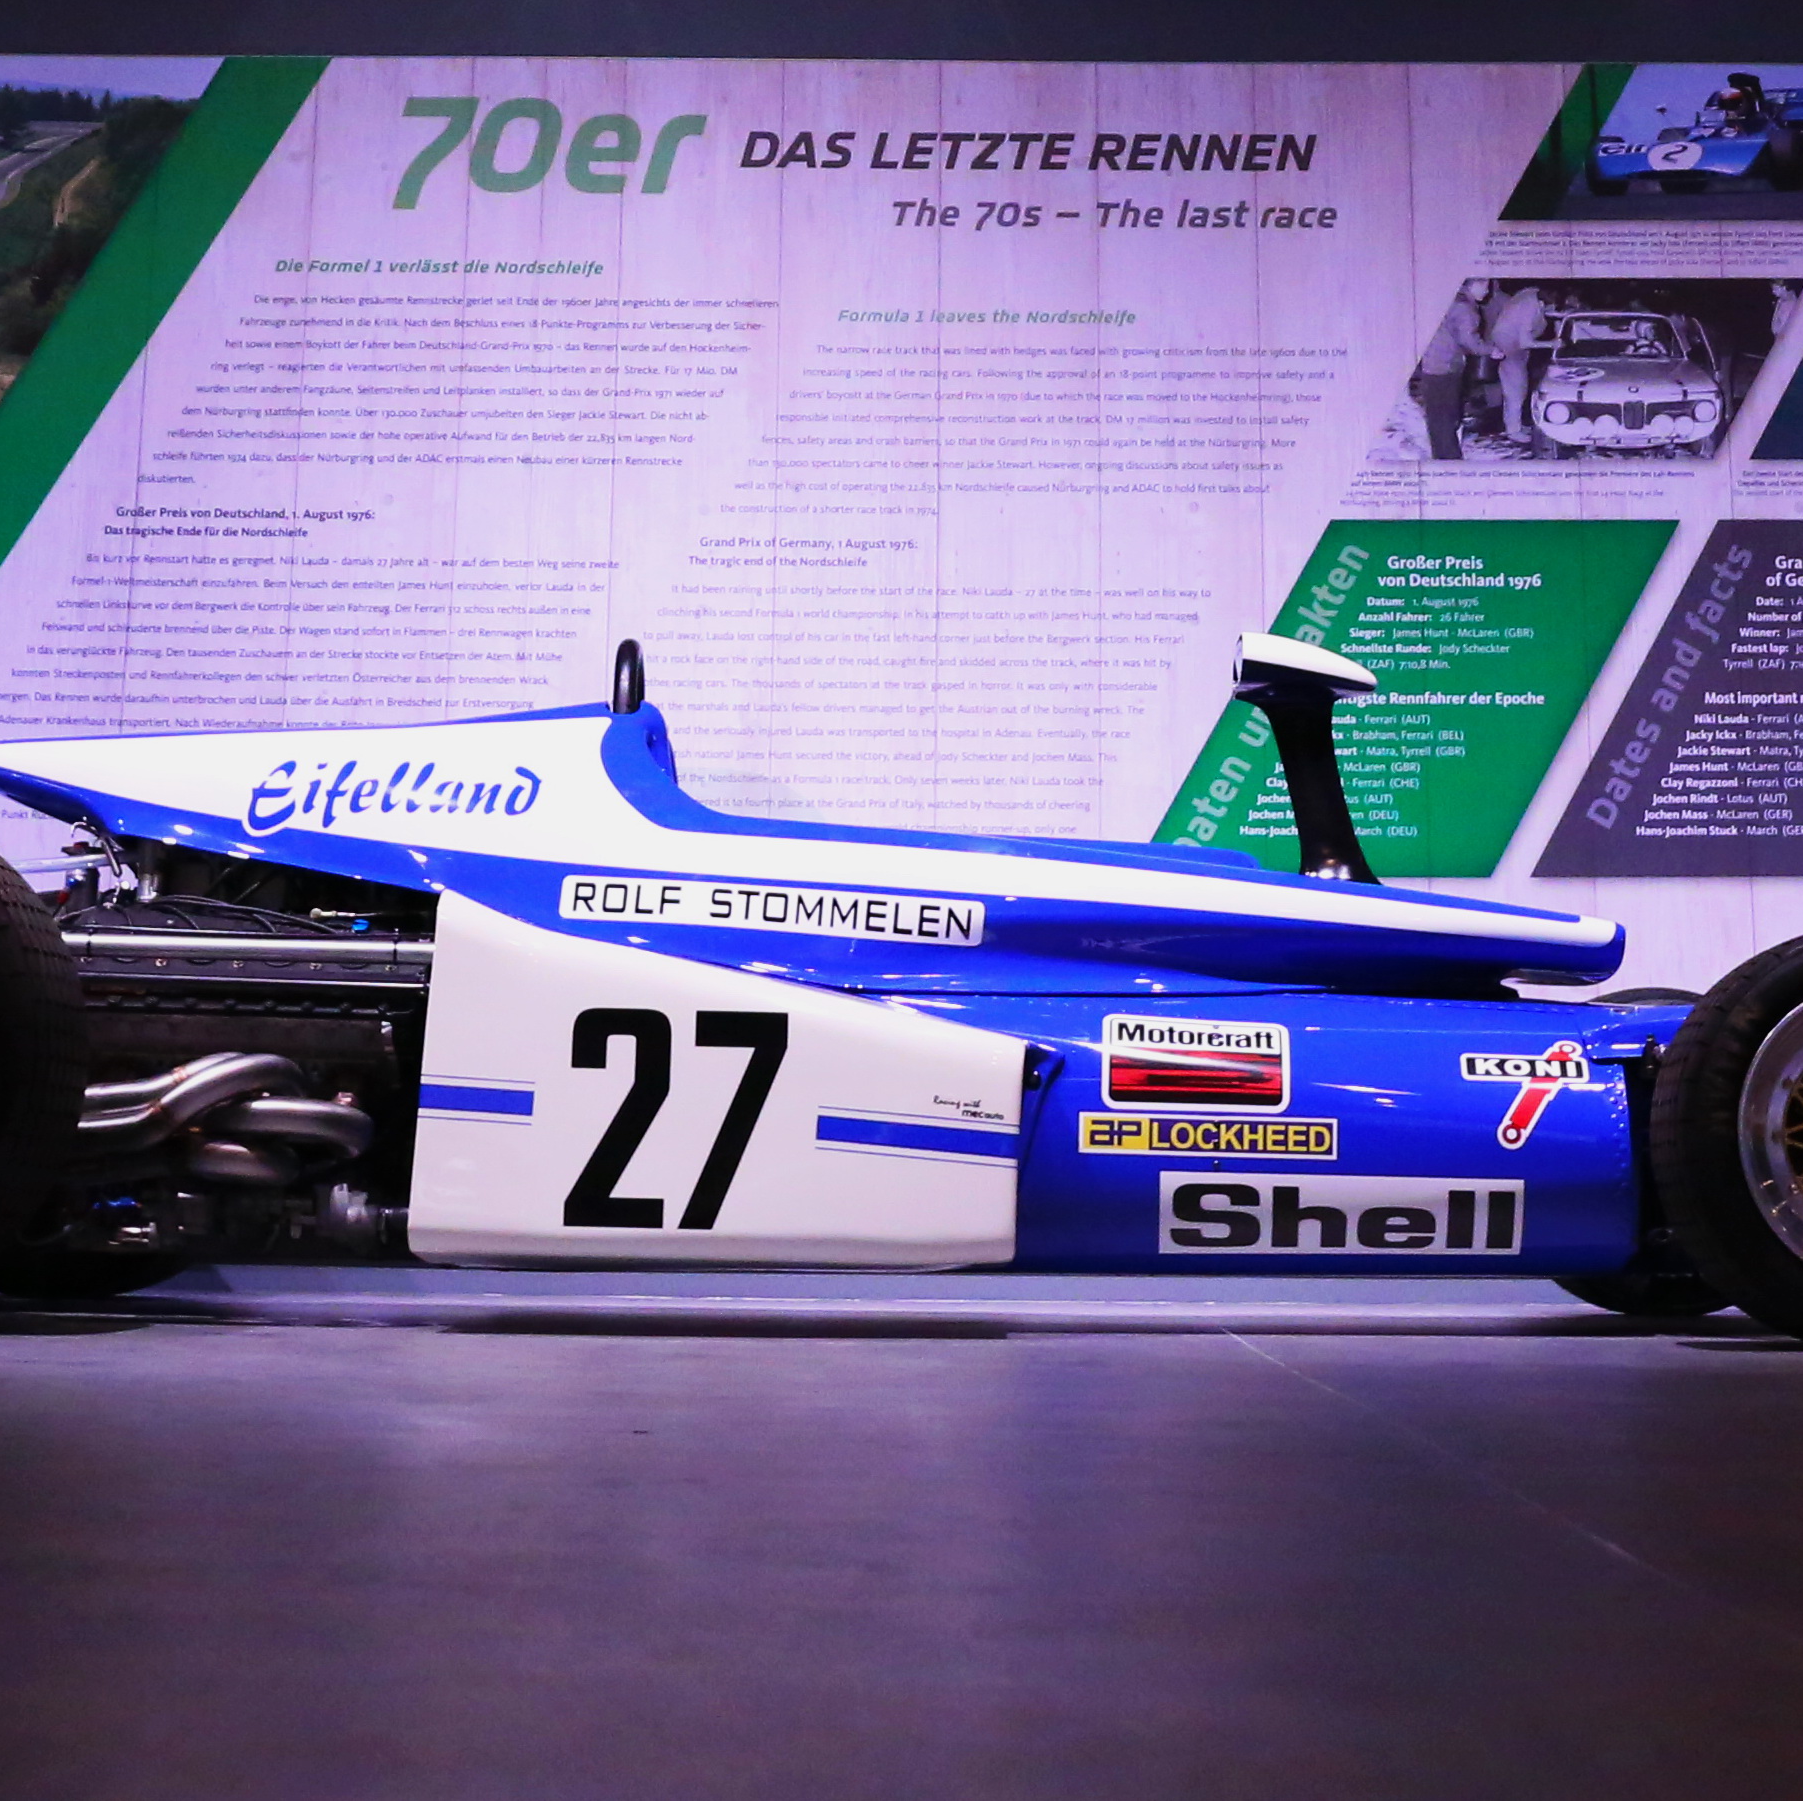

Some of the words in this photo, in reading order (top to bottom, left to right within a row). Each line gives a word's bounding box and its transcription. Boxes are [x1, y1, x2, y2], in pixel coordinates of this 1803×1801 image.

[393, 96, 707, 210] 70er
[740, 131, 855, 168] DAS
[870, 132, 1075, 170] LETZTE
[1089, 134, 1317, 172] RENNEN
[1661, 144, 1688, 163] 2
[893, 200, 960, 227] The
[976, 202, 1042, 231] 70s
[1096, 199, 1164, 228] The
[1177, 199, 1249, 228] last
[1260, 206, 1338, 229] race
[275, 259, 303, 273] Die
[308, 259, 370, 273] Formel
[373, 260, 383, 273] 1
[389, 260, 458, 273] verlässt
[463, 260, 489, 274] die
[495, 261, 604, 277] Nordschleife
[837, 307, 909, 323] Formula
[914, 310, 924, 322] 1
[929, 306, 986, 328] leaves
[992, 308, 1020, 323] the
[1025, 306, 1135, 327] Nordschleife
[115, 505, 157, 517] Großer
[159, 506, 188, 517] Preis
[190, 509, 211, 518] von
[213, 507, 289, 520] Deutschland,
[292, 509, 300, 520] 1.
[302, 508, 343, 522] August
[346, 509, 375, 521] 1976:
[104, 524, 123, 534] Das
[125, 525, 174, 538] tragische
[176, 525, 202, 536] Ende
[203, 525, 220, 536] für
[221, 526, 238, 536] die
[240, 527, 309, 539] Nordschleife
[699, 536, 735, 547] Grand
[738, 537, 760, 547] Prix
[763, 537, 776, 547] of
[778, 537, 834, 551] Germany,
[845, 538, 886, 551] August
[889, 538, 918, 551] 1976:
[688, 555, 708, 565] The
[710, 555, 741, 568] tragic
[743, 556, 763, 566] end
[765, 555, 777, 565] of
[778, 556, 797, 566] the
[799, 556, 867, 566] Nordschleife
[1387, 554, 1442, 570] Großer
[1445, 555, 1483, 569] Preis
[1376, 576, 1405, 586] von
[1408, 572, 1504, 587] Deutschland
[1507, 573, 1541, 590] 1976
[1765, 571, 1782, 586] of
[1366, 596, 1405, 607] Datum:
[1421, 596, 1455, 609] August
[1458, 596, 1479, 608] 1976
[1755, 595, 1783, 606] Date:
[1357, 610, 1393, 621] Anzahl
[1395, 611, 1432, 622] Fahrer:
[1438, 611, 1451, 622] 26
[1453, 611, 1484, 621] Fahrer
[1348, 627, 1385, 640] Sieger:
[1391, 627, 1421, 641] James
[1423, 627, 1448, 638] Hunt
[1456, 627, 1499, 637] McLaren
[1504, 627, 1534, 639] (GBR)
[1340, 643, 1393, 653] Schnellste
[1395, 642, 1432, 653] Runde:
[1438, 642, 1460, 655] Jody
[1462, 642, 1510, 653] Scheckter
[1587, 718, 1661, 830] Dates
[1651, 638, 1702, 712] and
[1684, 544, 1753, 645] facts
[1389, 691, 1466, 705] Rennfahrer
[1468, 690, 1492, 704] der
[1494, 691, 1544, 707] Epoche
[1704, 691, 1735, 704] Most
[1736, 690, 1798, 707] important
[249, 761, 542, 829] Eifelland
[573, 882, 680, 915] ROLF
[710, 889, 974, 940] STOMMELEN
[1117, 1022, 1274, 1050] Motorcraft
[1475, 1056, 1583, 1078] KONI
[563, 1007, 789, 1231] 27
[1151, 1123, 1331, 1152] LOCKHEED
[1170, 1182, 1516, 1250] Shell
